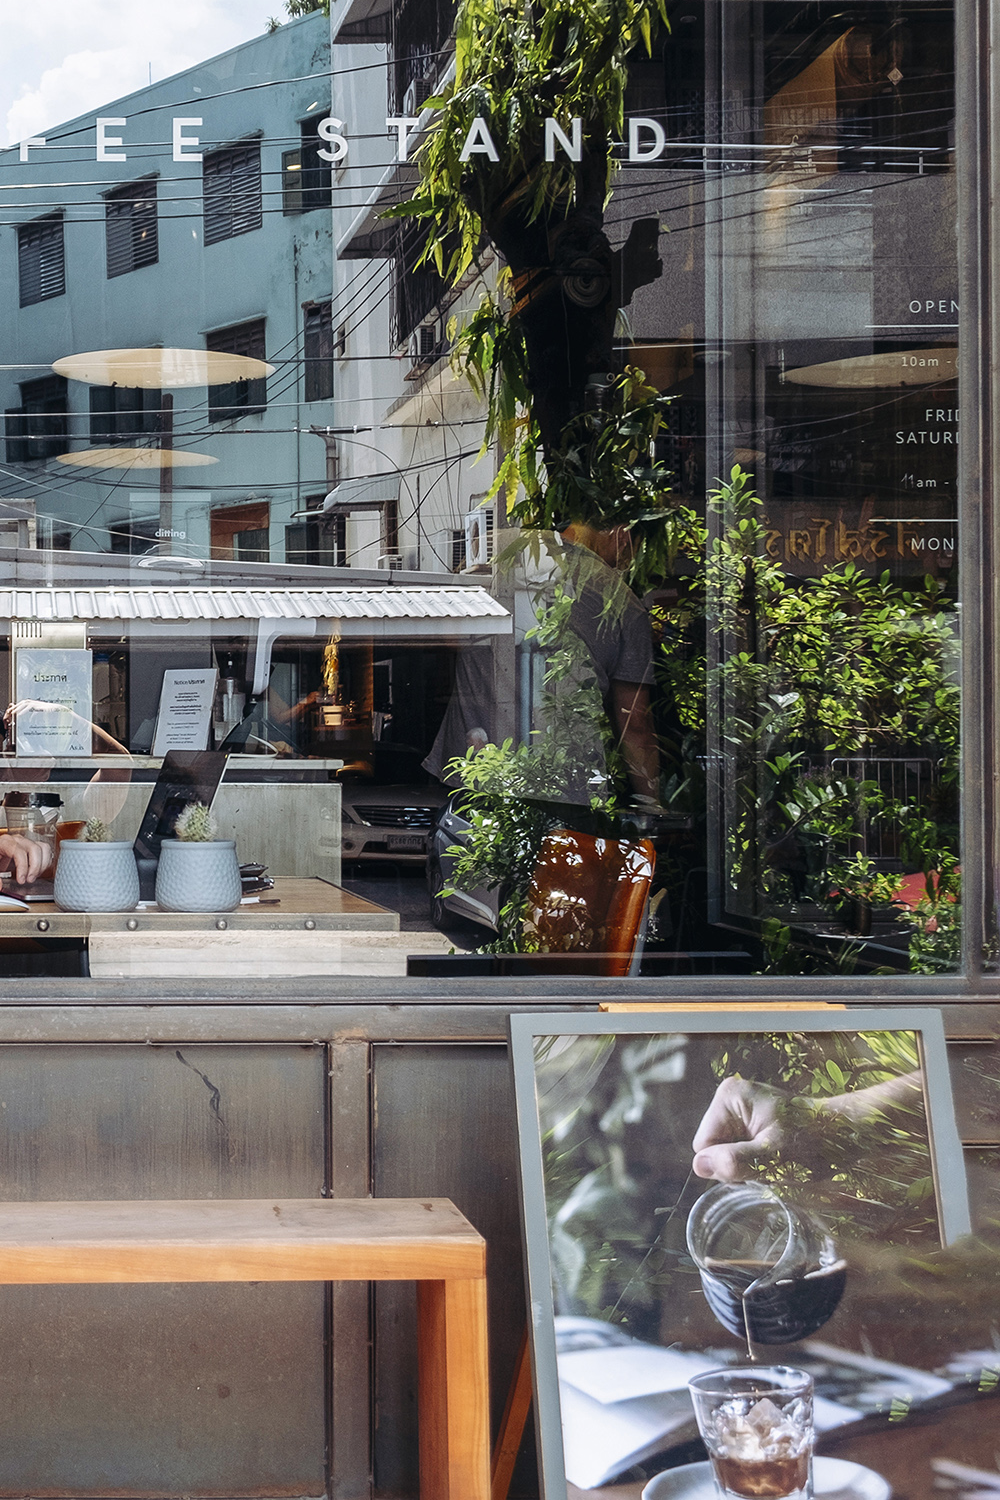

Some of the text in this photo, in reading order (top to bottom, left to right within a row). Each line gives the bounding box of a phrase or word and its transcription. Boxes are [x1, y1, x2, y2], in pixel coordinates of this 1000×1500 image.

[316, 116, 666, 163] STAND
[901, 356, 939, 367] 10am
[154, 528, 186, 540] ditting
